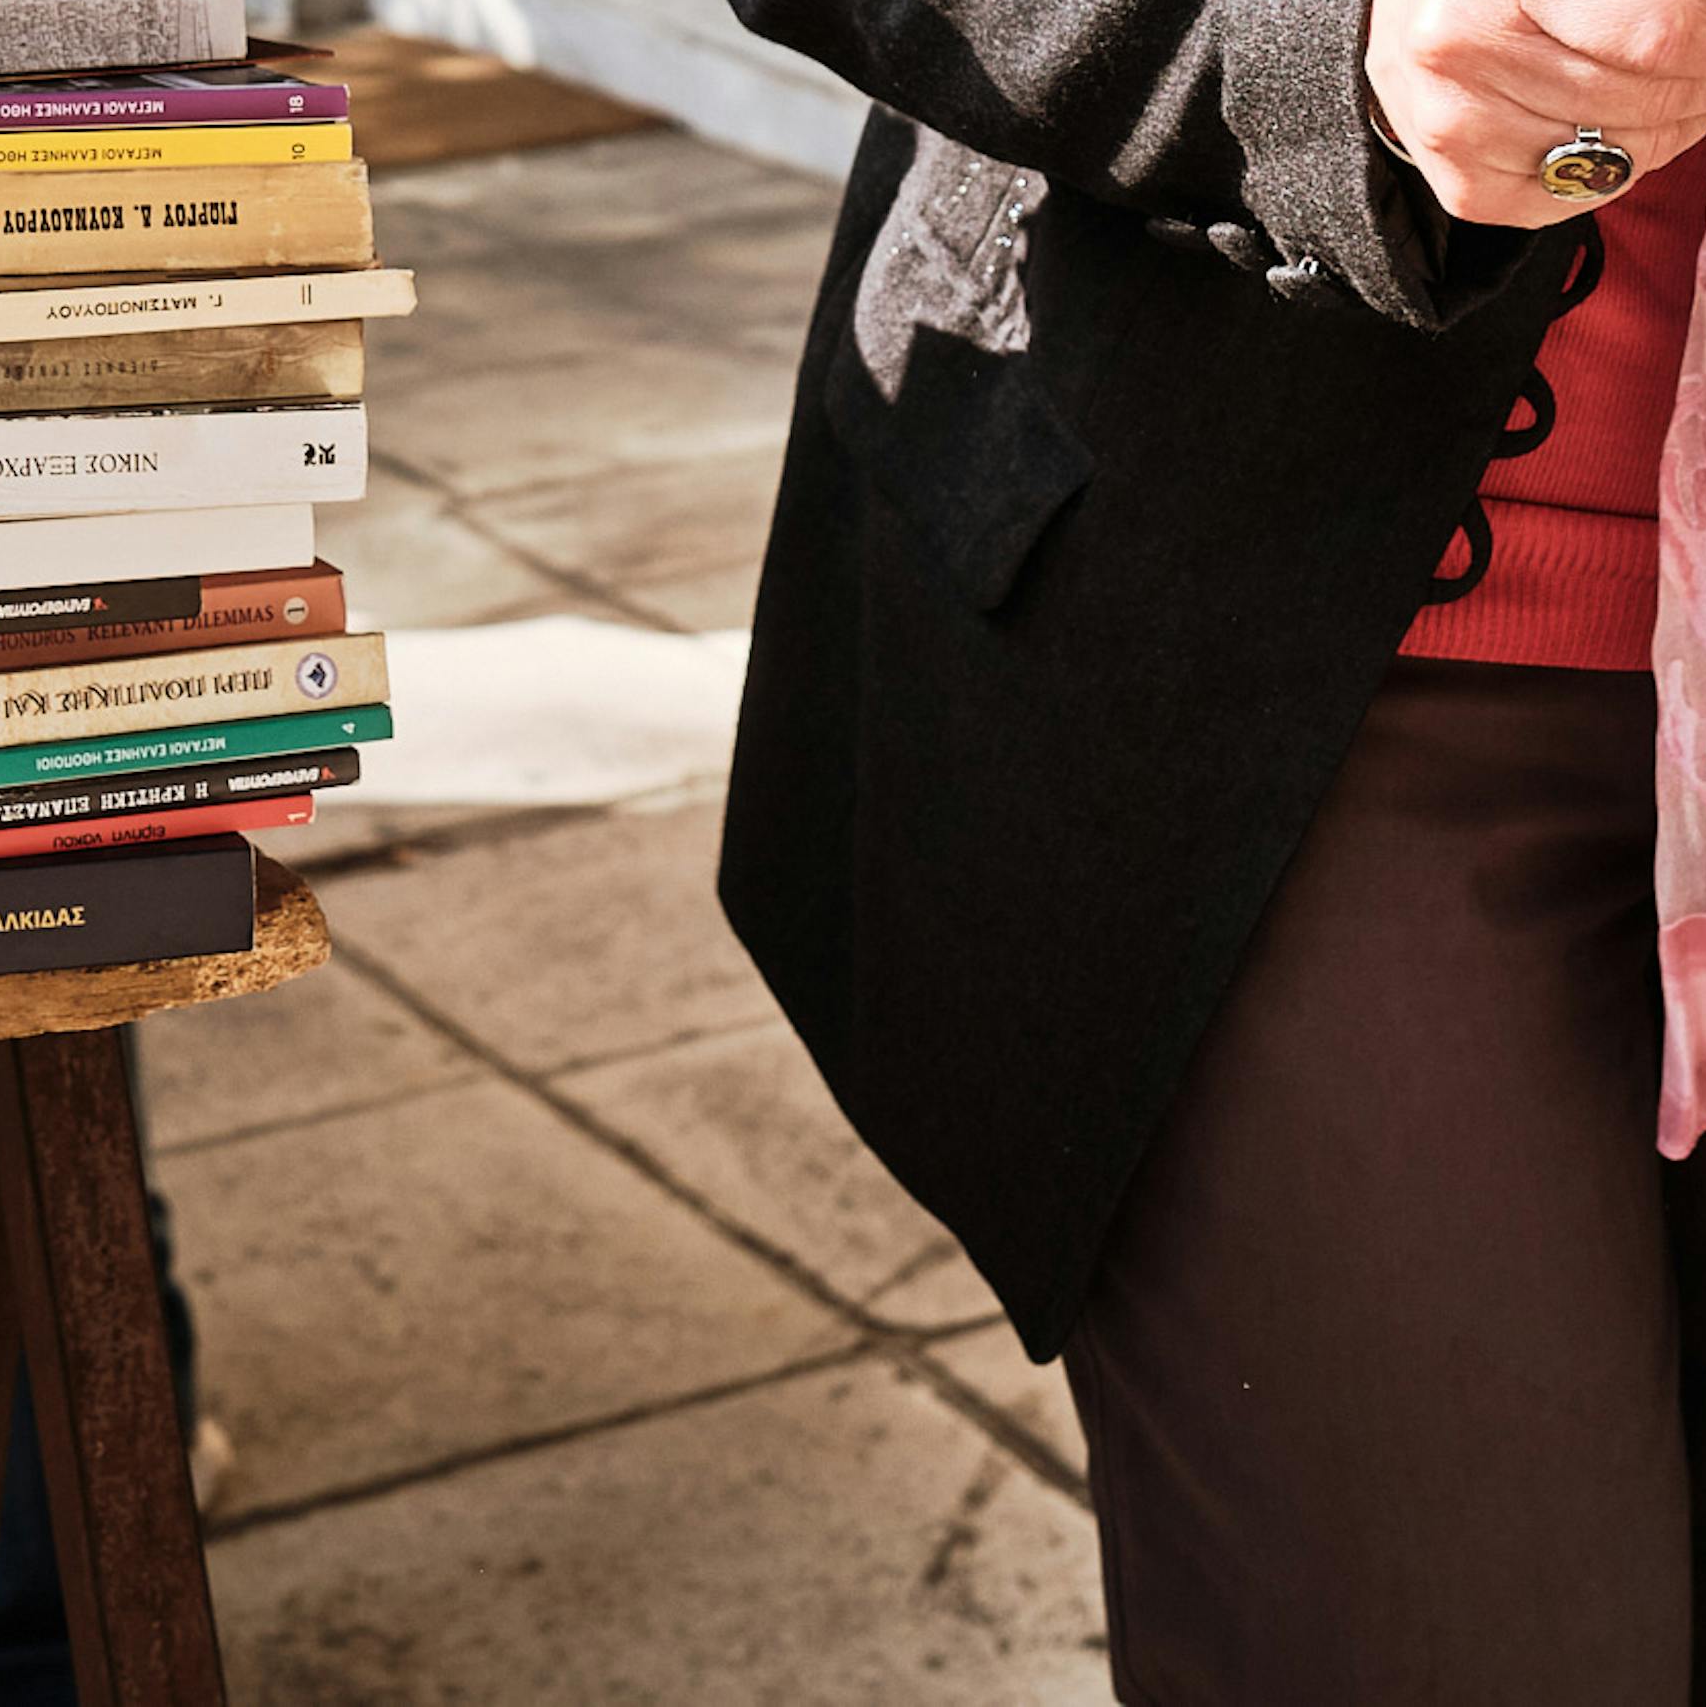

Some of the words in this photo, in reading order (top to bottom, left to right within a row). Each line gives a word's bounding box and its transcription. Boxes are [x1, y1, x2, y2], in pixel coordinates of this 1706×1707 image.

[34, 101, 100, 117] ΕΛΛΗΝΕΣ
[102, 99, 164, 115] ΜΕΓΑΛΟΙ
[30, 147, 97, 162] ΕΛΛΗΝΕΣ
[100, 146, 162, 161] ΜΕΓΑΛΟΙ
[132, 204, 153, 227] Δ.
[162, 201, 238, 227] ΓΙΩΡΓΟΥ
[46, 296, 197, 319] ΜΑΤΣΙΝΟΠΟΥΛΟΥ
[85, 452, 158, 475] ΝΙΚΟΣ
[88, 618, 175, 641] RELEVANT
[183, 604, 274, 631] DILEMMAS
[212, 668, 273, 696] ΠΕΡΙ
[105, 742, 169, 761] ΕΛΛΗΝΕΣ
[171, 735, 227, 754] ΜΕΓΑΛΟΙ
[35, 750, 103, 770] ΗΘΟΠΟΙΟΙ
[100, 783, 186, 811] ΚΡΗΤΙΚΗ
[194, 781, 208, 799] Η
